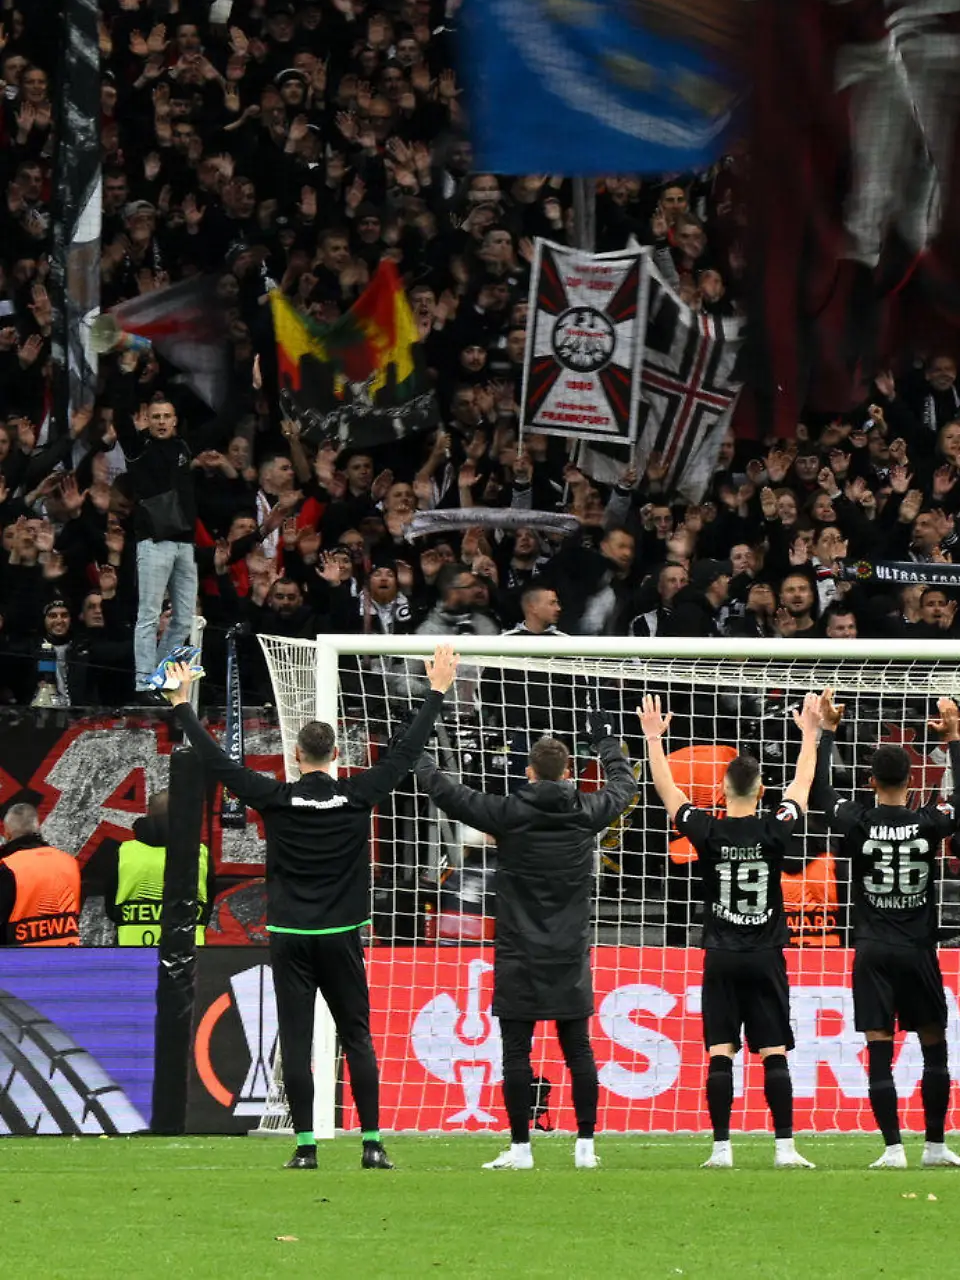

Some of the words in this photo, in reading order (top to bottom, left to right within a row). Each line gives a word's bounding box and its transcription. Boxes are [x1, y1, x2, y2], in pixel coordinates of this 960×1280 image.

[875, 565, 928, 582] ULTRAS
[720, 843, 763, 861] BORRÉ
[862, 837, 929, 895] 36
[714, 861, 770, 914] 19
